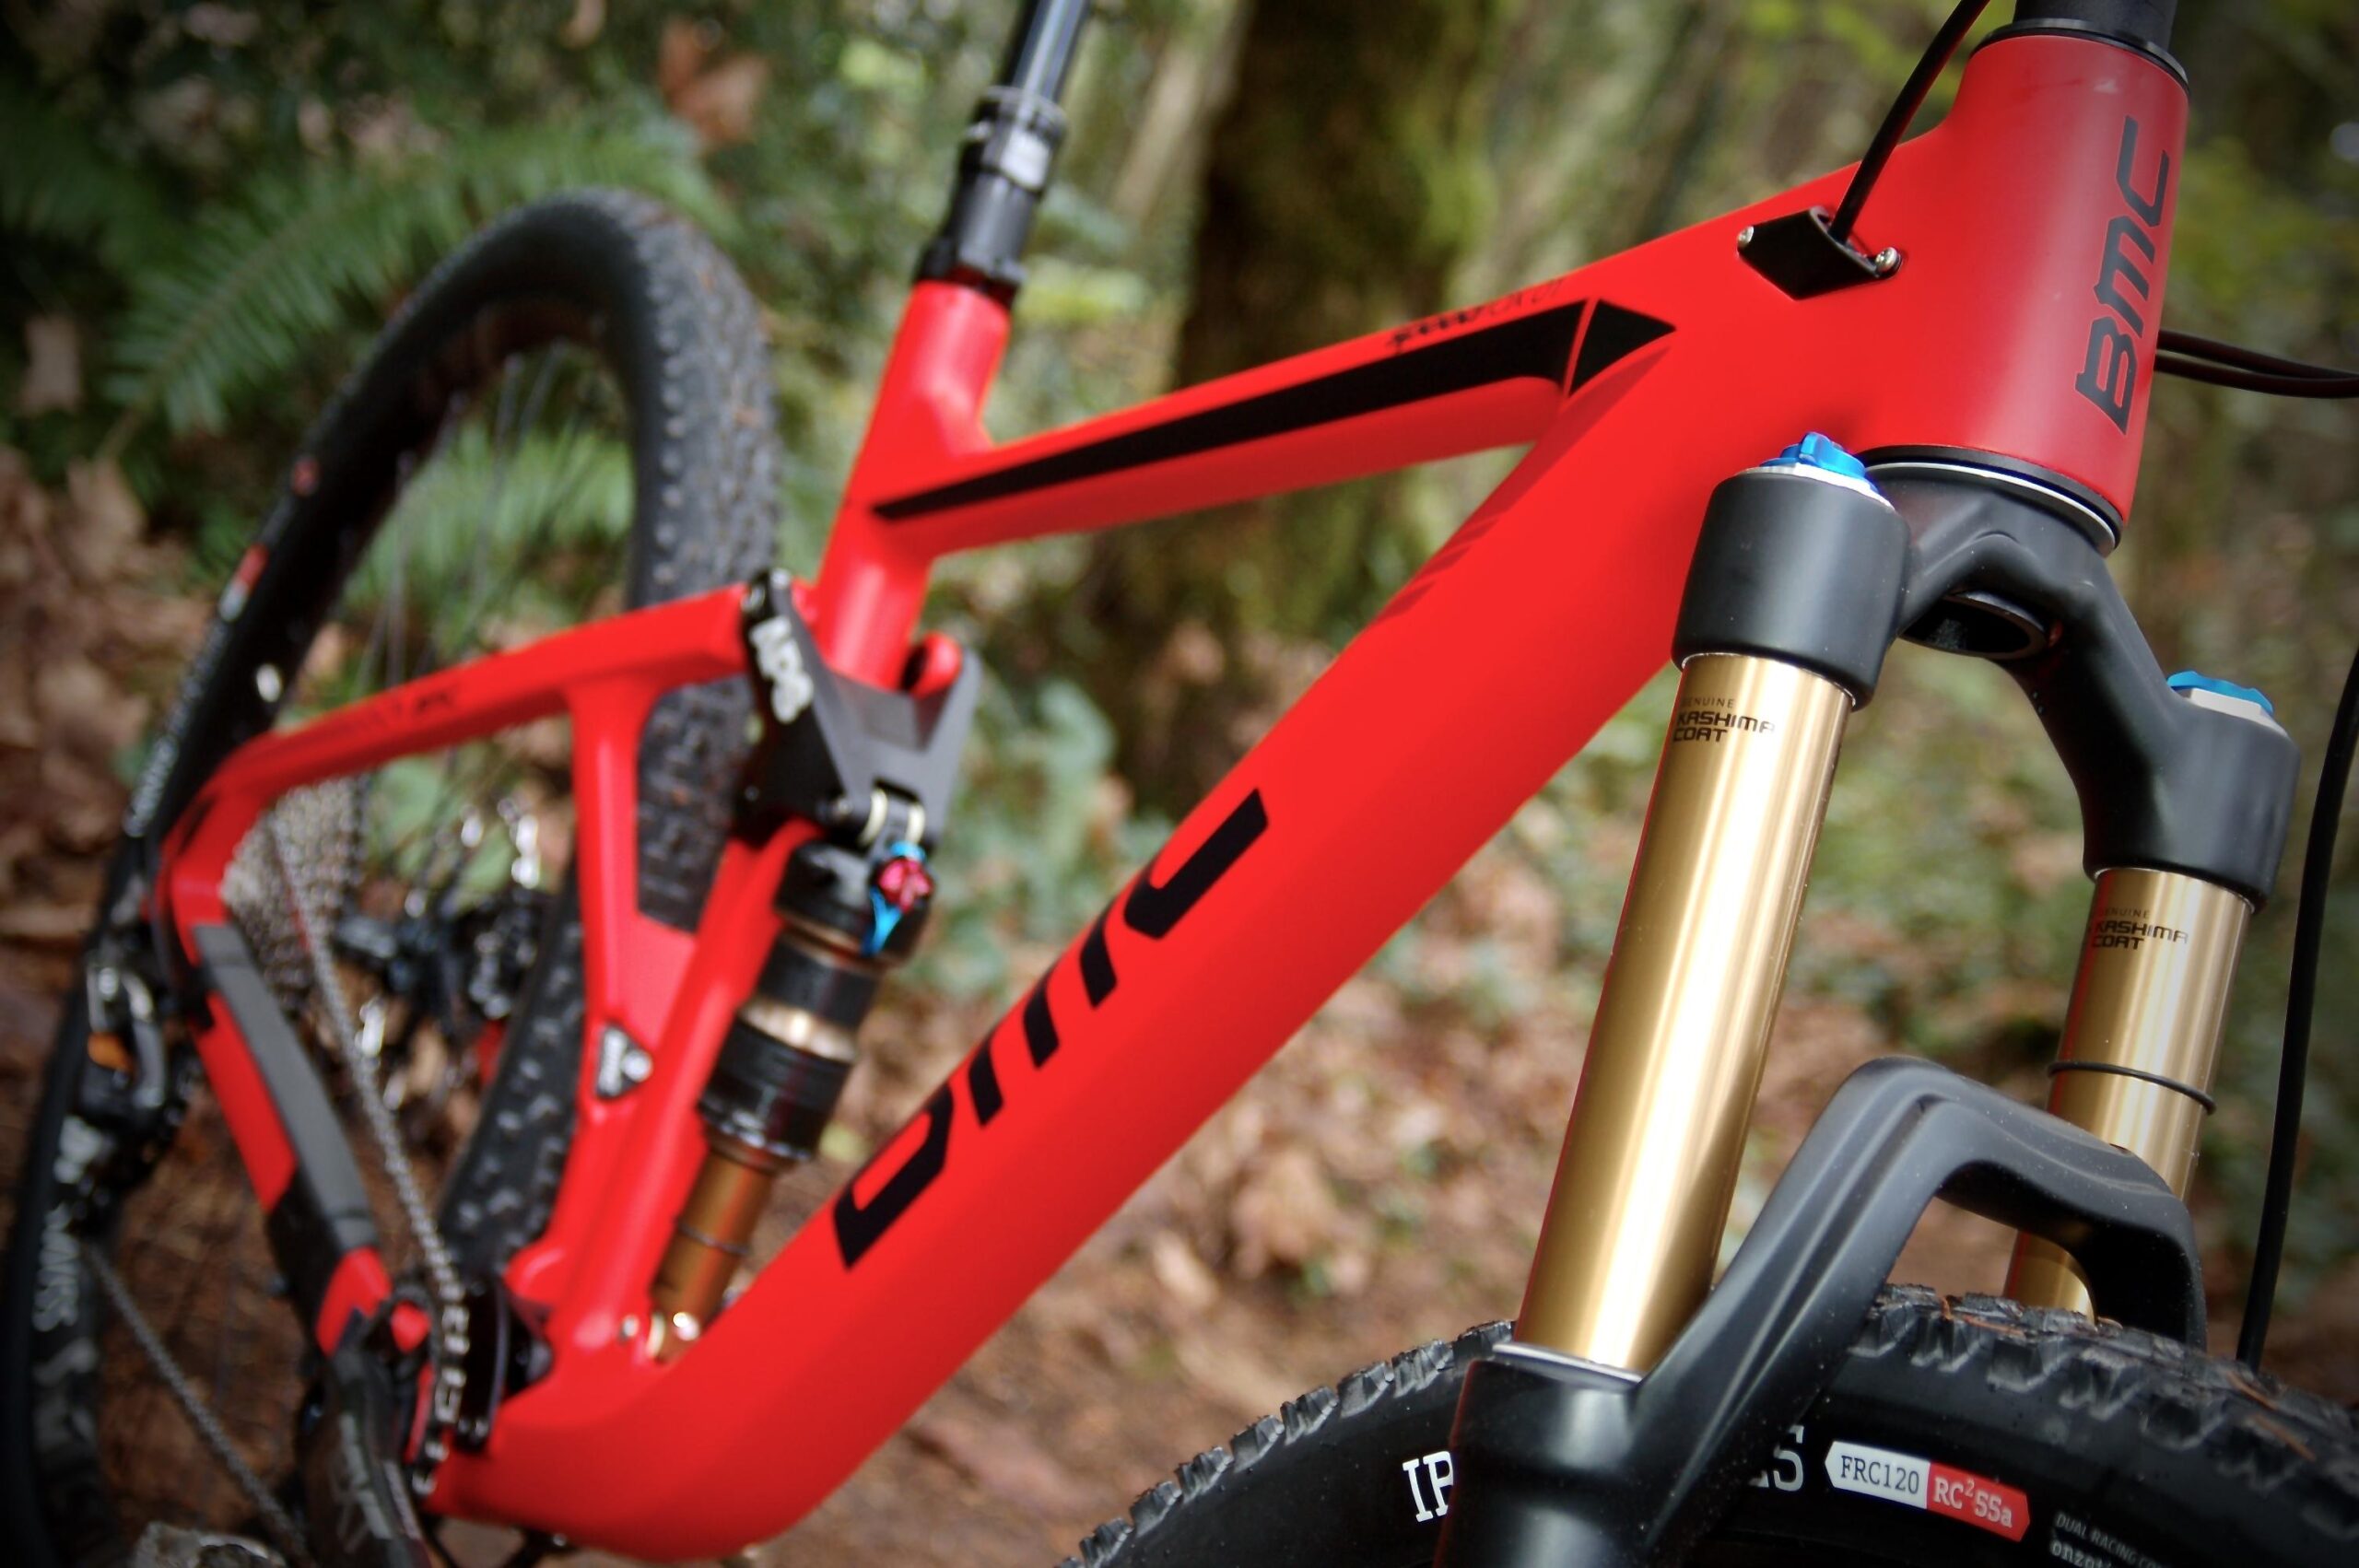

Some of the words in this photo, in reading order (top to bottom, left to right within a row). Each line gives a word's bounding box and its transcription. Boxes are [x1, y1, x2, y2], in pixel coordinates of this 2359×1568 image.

[2075, 115, 2169, 436] BMC
[1677, 710, 1776, 733] KASHIMA
[1673, 726, 1728, 743] COAT
[2092, 934, 2145, 950] COAT
[2095, 920, 2189, 944] KASHIMA
[1841, 1455, 1920, 1495] FRC120
[2055, 1513, 2088, 1540] DUAL
[2089, 1527, 2138, 1564] RACING
